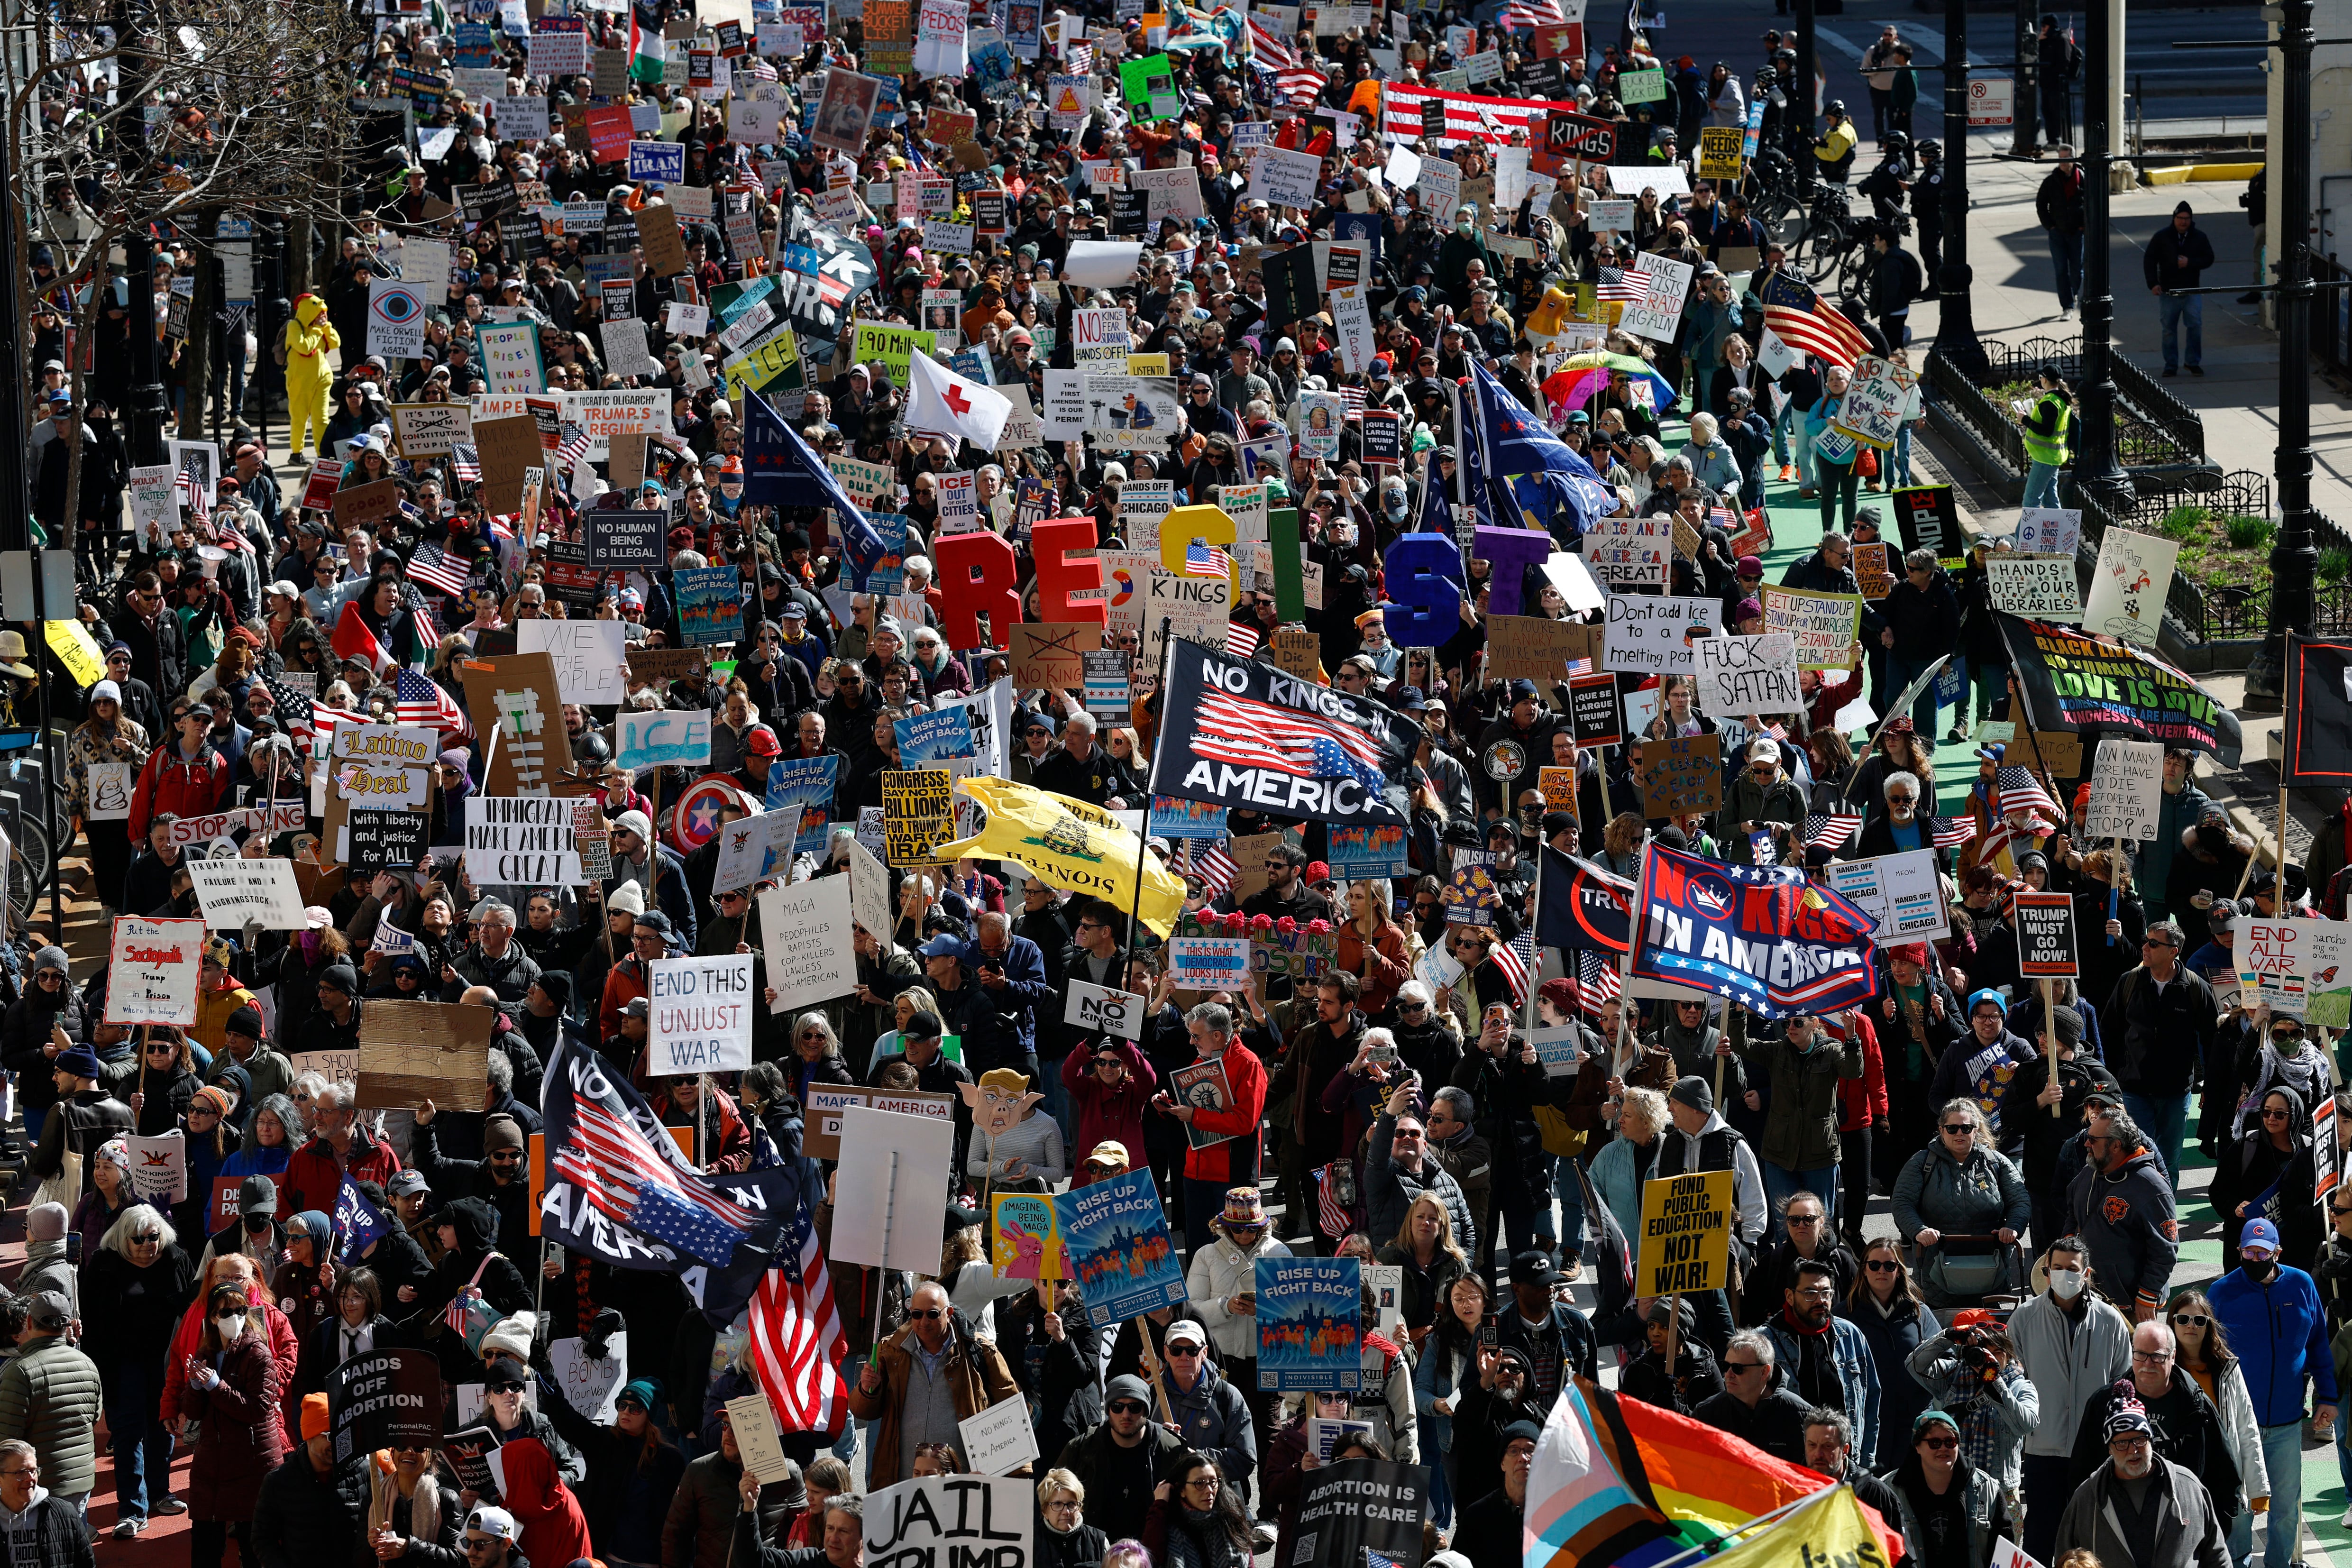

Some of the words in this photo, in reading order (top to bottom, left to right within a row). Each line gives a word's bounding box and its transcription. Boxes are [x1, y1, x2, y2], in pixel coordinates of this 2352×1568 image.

[863, 1, 909, 15] SUMMER
[865, 16, 907, 28] BUCKET
[864, 28, 897, 40] LIST
[1620, 74, 1644, 87] FUCK
[1647, 73, 1664, 84] ICE
[1622, 90, 1645, 101] FUCK
[1648, 85, 1664, 97] DJT
[1551, 120, 1611, 155] KINGS
[1702, 137, 1740, 154] NEEDS
[1704, 153, 1736, 161] NOT
[633, 156, 679, 174] IRAN
[1422, 159, 1455, 175] CLEANUP
[660, 171, 680, 180] WAR
[1615, 169, 1650, 179] THIS
[1653, 169, 1670, 179] IS
[1421, 174, 1433, 184] ON
[1436, 179, 1456, 193] AISLE
[1614, 181, 1636, 191] NOT
[564, 203, 589, 211] HANDS
[1426, 192, 1452, 217] 47
[604, 288, 631, 296] TRUMP
[607, 296, 630, 304] MUST
[1334, 299, 1364, 313] PEOPLE
[609, 311, 631, 319] NOW!
[1102, 311, 1123, 321] KINGS
[1341, 315, 1362, 327] HAVE
[370, 325, 391, 335] MAKE
[394, 327, 423, 338] ORWELL
[1077, 312, 1101, 343] NO
[1103, 321, 1120, 332] FEAR
[1345, 328, 1360, 337] THE
[376, 336, 417, 345] FICTION
[486, 332, 525, 344] PEOPLE
[382, 347, 409, 356] AGAIN
[493, 348, 529, 361] RISE!
[1075, 347, 1101, 360] HANDS
[1103, 347, 1126, 360] OFF!
[496, 369, 531, 379] KINGS
[1857, 363, 1881, 379] NO
[1867, 379, 1897, 405] FAUX
[1848, 395, 1875, 414] KING
[939, 475, 972, 489] ICE
[946, 489, 967, 501] OUT
[942, 504, 974, 517] CITIES
[596, 524, 613, 533] NO
[616, 523, 655, 533] HUMAN
[611, 536, 642, 546] BEING
[1601, 536, 1646, 549] Make
[596, 548, 607, 558] IS
[610, 547, 657, 558] ILLEGAL
[1590, 550, 1661, 563] AMERICA
[1596, 564, 1667, 583] GREAT!
[1999, 563, 2059, 576] HANDS
[1992, 582, 2024, 594] OFF
[2041, 581, 2076, 594] OUR
[1657, 604, 1681, 619] add
[1688, 601, 1709, 620] ice
[1992, 598, 2074, 611] LIBRARIES
[1627, 624, 1643, 638] to
[1661, 627, 1671, 638] a
[1611, 646, 1664, 667] melting
[1670, 649, 1694, 667] pot
[1702, 636, 1766, 669] FUCK
[1718, 669, 1797, 706] SATAN
[1203, 659, 1248, 694] NO
[1268, 676, 1358, 723] KINGS
[1370, 714, 1391, 741] IN
[883, 771, 949, 788] CONGRESS:
[883, 789, 906, 797] SAY
[907, 788, 929, 796] NO
[930, 787, 949, 795] TO
[886, 797, 952, 818] BILLIONS
[174, 816, 227, 842] STOP
[228, 818, 243, 831] the
[245, 807, 305, 833] LYNG
[355, 814, 379, 825] with
[386, 814, 422, 831] liberty
[356, 828, 377, 842] and
[381, 831, 417, 847] justice
[362, 850, 380, 862] for
[386, 847, 413, 863] ALL
[191, 862, 225, 871] TRUMP
[204, 878, 237, 886] FAILURE
[206, 895, 270, 910] LAUGHINGSTOCK
[784, 898, 815, 917] MAGA
[2020, 908, 2068, 922] TRUMP
[779, 922, 829, 942] PEDOPHILES
[2026, 923, 2064, 935] MUST
[2251, 926, 2297, 942] END
[787, 938, 822, 953] RAPISTS
[2036, 936, 2057, 949] GO
[781, 947, 835, 967] COP-KILLERS
[1186, 947, 1203, 957] THIS
[1204, 947, 1211, 957] IS
[1212, 947, 1233, 957] WHAT
[2030, 949, 2067, 962] NOW!
[2249, 942, 2296, 958] ALL
[785, 961, 822, 977] LAWLESS
[1186, 958, 1233, 968] DEMOCRACY
[2249, 956, 2295, 974] WAR
[1185, 968, 1210, 978] LOOKS
[1213, 969, 1233, 978] LIKE
[655, 971, 696, 997] END
[702, 967, 746, 994] THIS
[779, 972, 839, 991] UN-AMERICAN
[660, 1005, 741, 1034] UNJUST
[670, 1040, 721, 1065] WAR
[1672, 1177, 1705, 1195] FUND
[1664, 1194, 1710, 1215] PUBLIC
[1649, 1211, 1722, 1237] EDUCATION
[1664, 1235, 1703, 1263] NOT
[1276, 1268, 1313, 1281] RISE
[1318, 1268, 1341, 1280] UP
[1656, 1265, 1709, 1293] WAR!
[1265, 1282, 1309, 1299] FIGHT
[1312, 1282, 1354, 1299] BACK
[342, 1357, 402, 1385] HANDS
[353, 1376, 387, 1397] OFF
[339, 1394, 424, 1429] ABORTION
[388, 1423, 432, 1431] PersonalPAC
[866, 1481, 1022, 1554] JAIL
